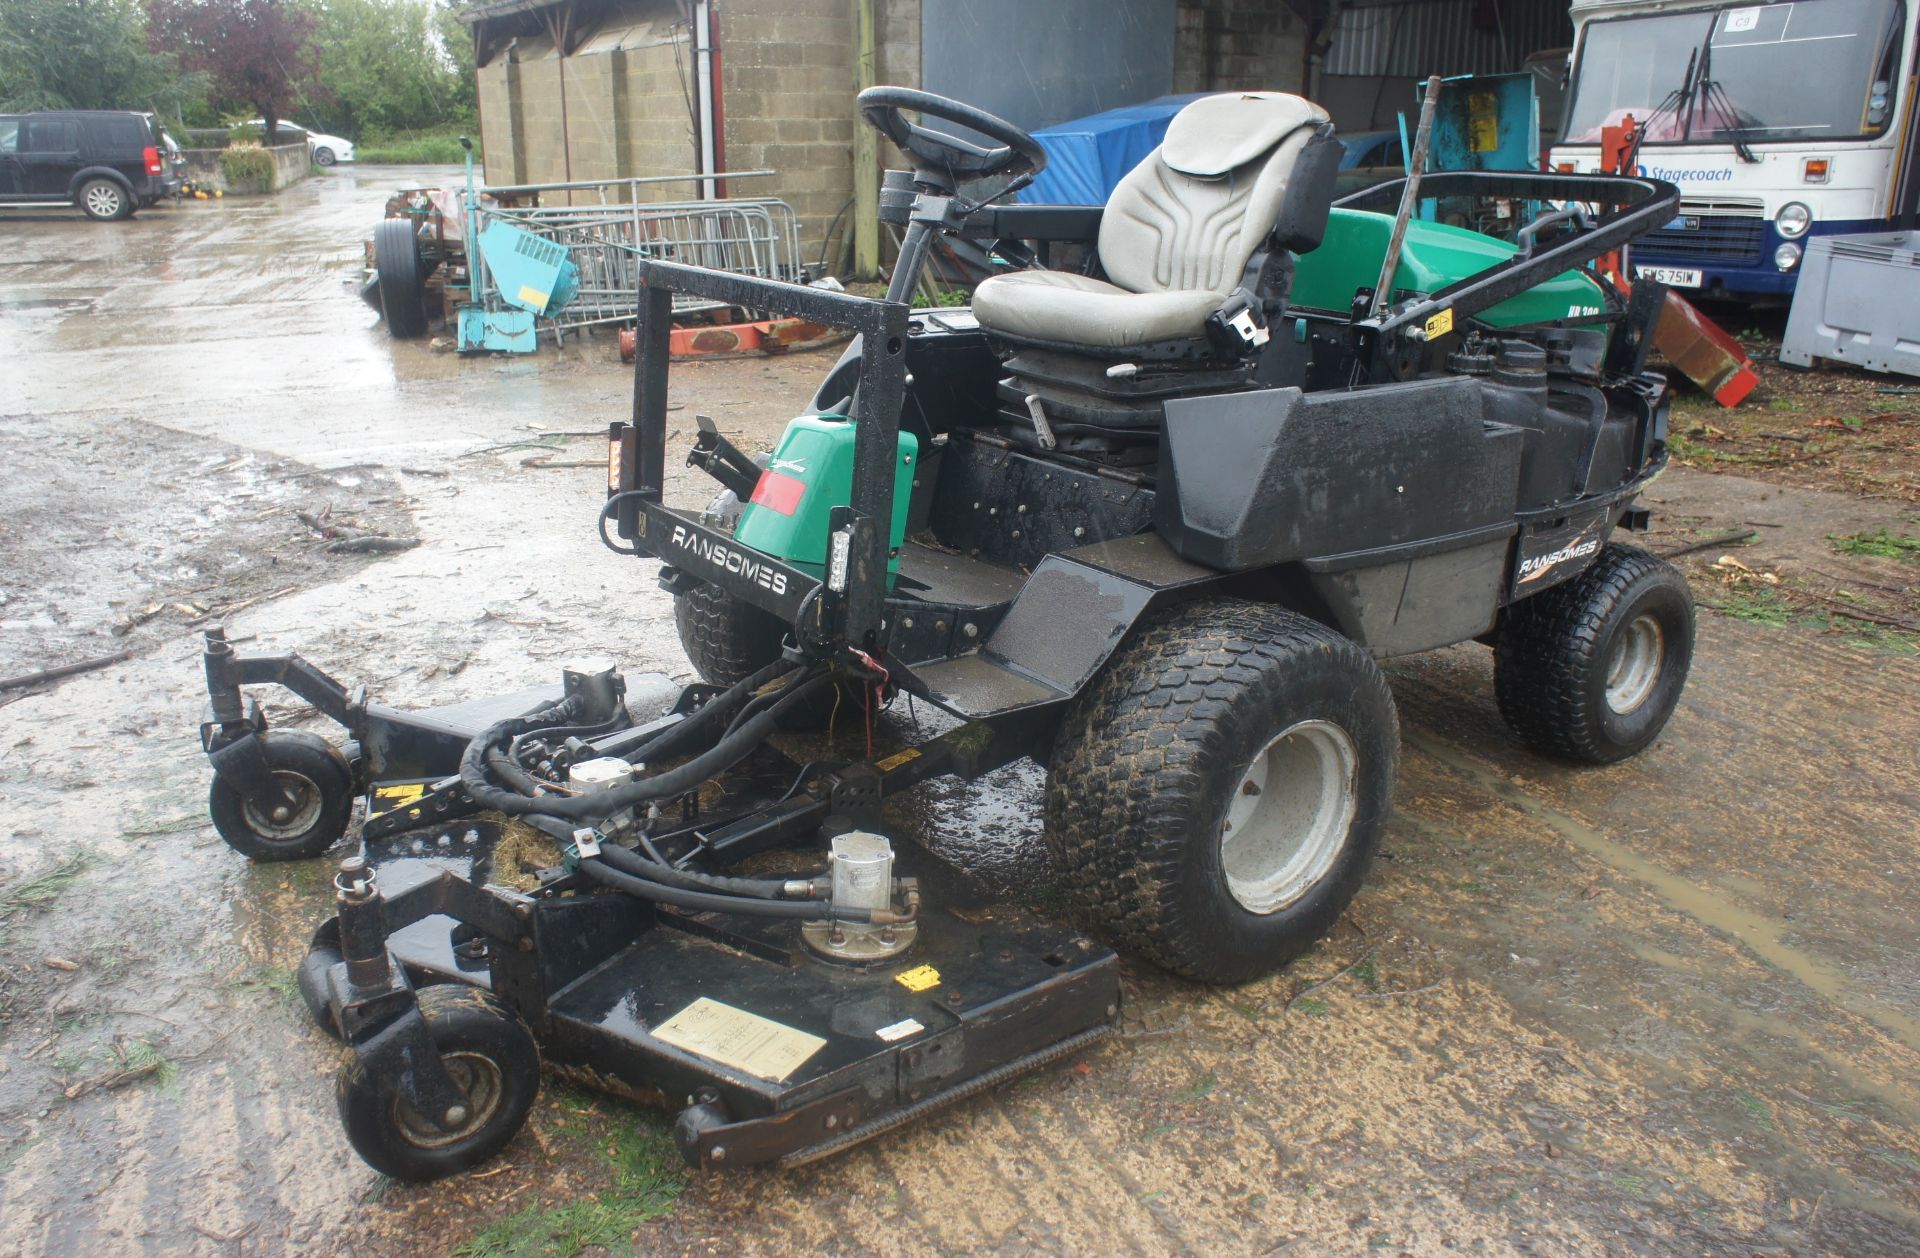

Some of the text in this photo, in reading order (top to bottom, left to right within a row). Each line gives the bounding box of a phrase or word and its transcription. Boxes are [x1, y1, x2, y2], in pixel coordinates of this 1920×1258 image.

[1652, 167, 1732, 183] Stagecoach
[672, 525, 788, 595] RANSOMES
[1519, 540, 1597, 574] RANSOMES
